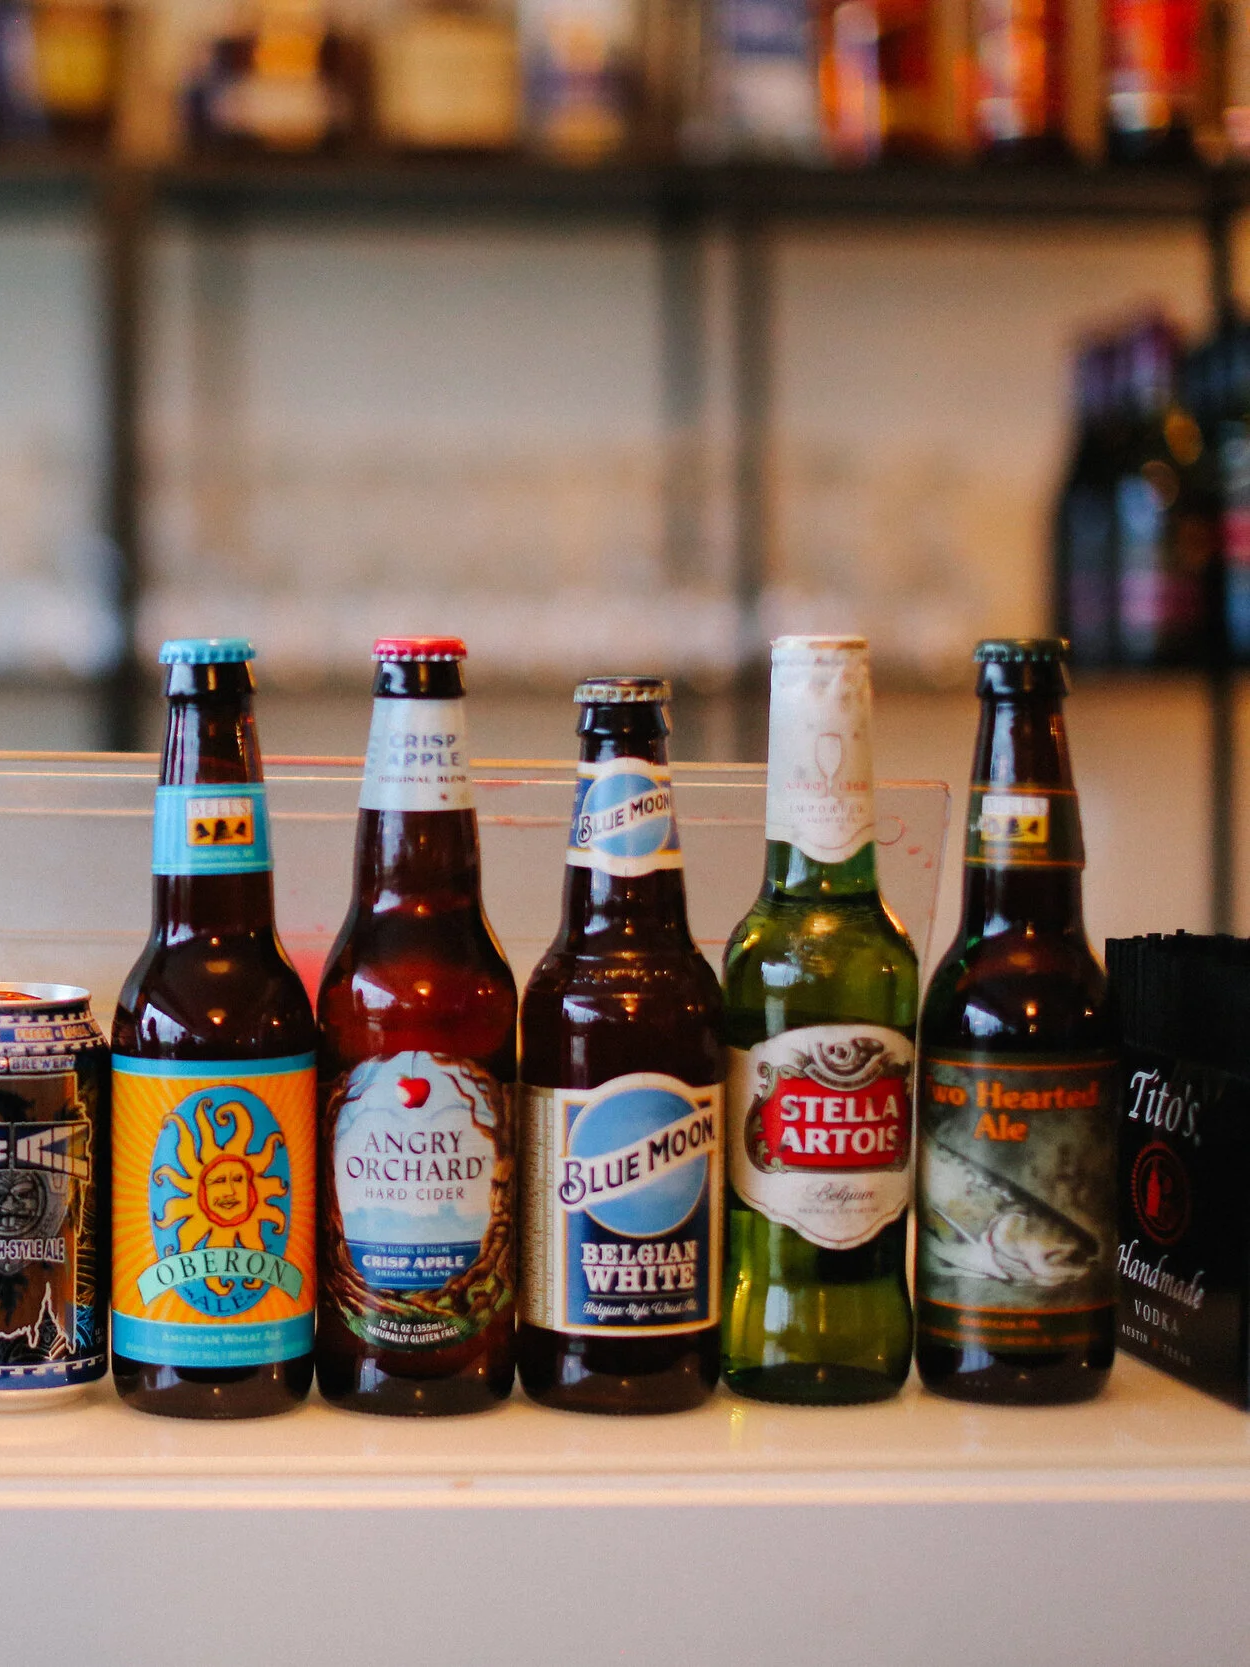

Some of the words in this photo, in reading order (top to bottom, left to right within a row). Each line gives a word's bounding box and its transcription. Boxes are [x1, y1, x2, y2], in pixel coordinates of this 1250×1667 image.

[389, 733, 456, 749] CRISP
[388, 752, 461, 767] APPLE
[378, 775, 432, 784] ORIGINAL
[436, 775, 467, 784] BLEND
[577, 809, 625, 844] BLUE
[628, 793, 670, 821] MOON
[11, 1057, 76, 1070] BREWERY
[926, 1074, 968, 1107] wo
[975, 1079, 1100, 1110] Hearted
[1128, 1068, 1199, 1138] Tito's
[779, 1093, 900, 1123] STELLA
[974, 1112, 1028, 1142] Ale
[364, 1130, 463, 1154] ANGRY
[779, 1124, 900, 1155] ARTOIS
[346, 1156, 484, 1182] ORCHARD
[558, 1151, 640, 1205] BLUE
[648, 1113, 713, 1172] MOON
[365, 1187, 407, 1200] HARD
[415, 1186, 465, 1200] CIDER
[45, 1238, 65, 1261] ALE
[361, 1254, 410, 1269] CRISP
[413, 1255, 465, 1269] APPLE
[580, 1240, 699, 1265] BELGIAN
[156, 1251, 288, 1287] OBERON
[375, 1269, 418, 1278] ORIGINAL
[422, 1270, 452, 1278] BLEND
[581, 1263, 696, 1292] WHITE
[1117, 1239, 1206, 1310] Handmade
[192, 1292, 245, 1313] ALE
[379, 1319, 387, 1329] 12
[388, 1322, 398, 1331] FL
[400, 1324, 411, 1333] OZ
[1134, 1299, 1180, 1337] VODKA
[367, 1324, 409, 1343] NATURALLY
[409, 1331, 440, 1343] GLUTEN
[441, 1326, 459, 1337] FREE
[1121, 1323, 1149, 1345] AUSTIN
